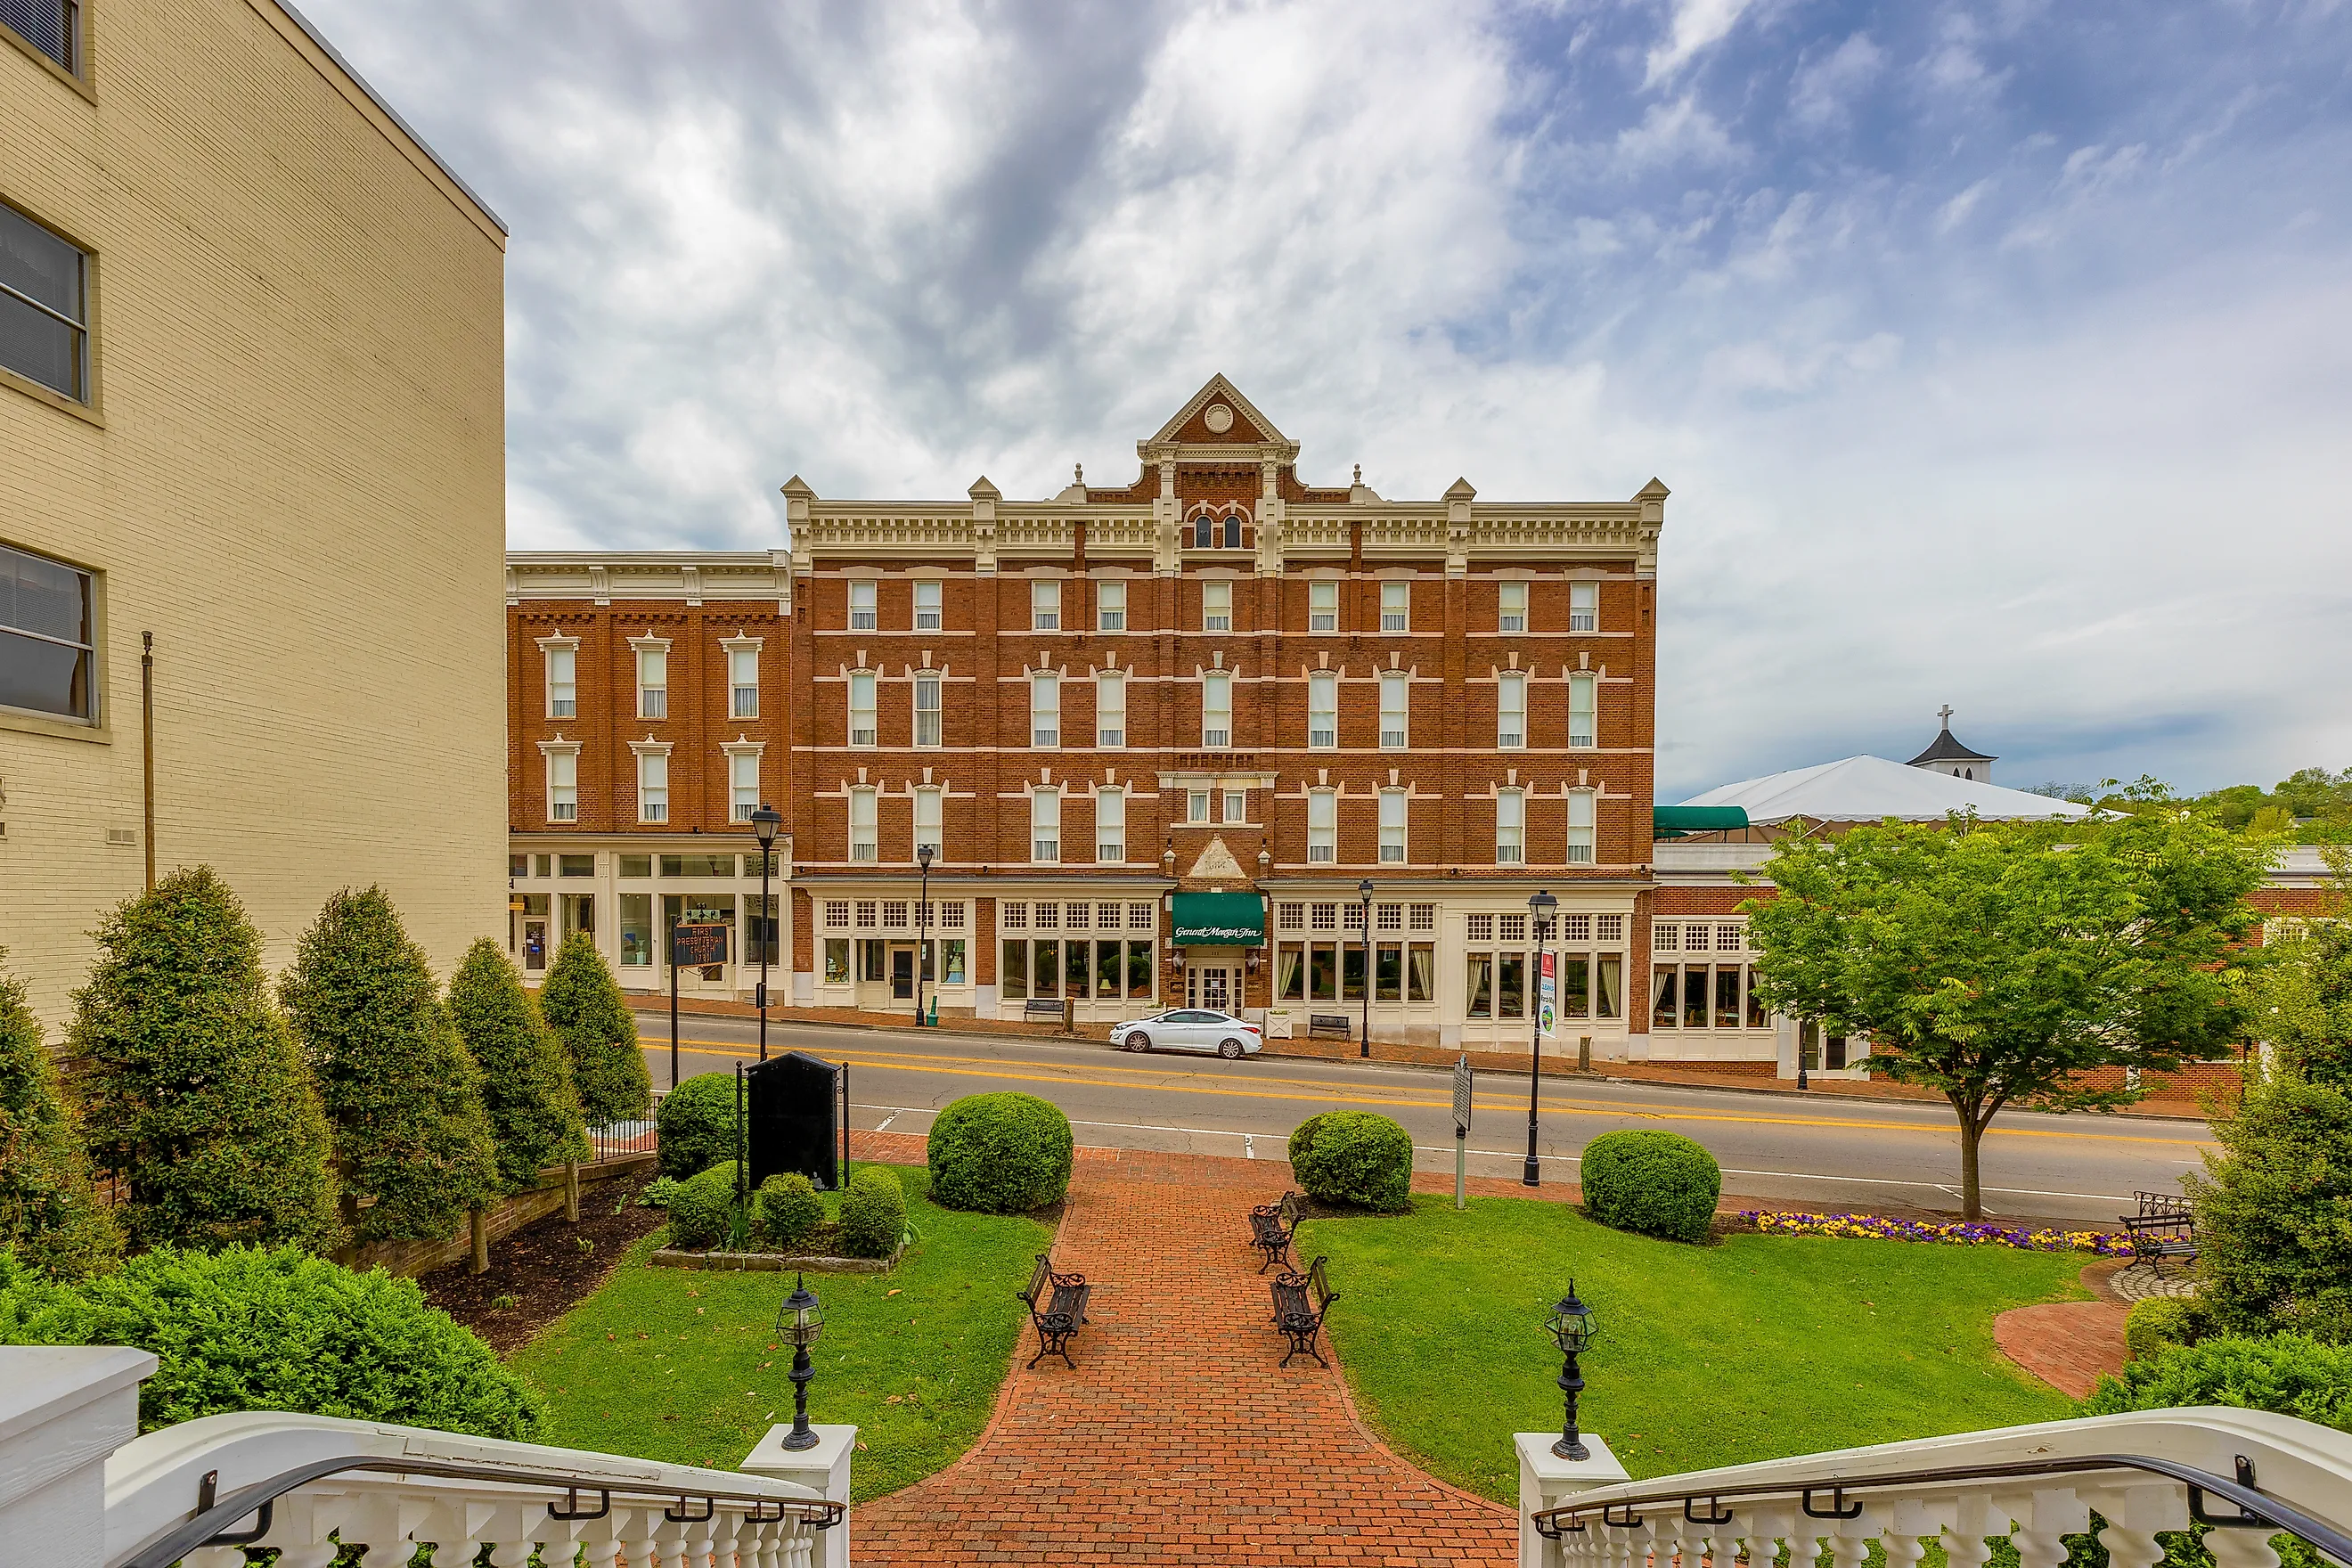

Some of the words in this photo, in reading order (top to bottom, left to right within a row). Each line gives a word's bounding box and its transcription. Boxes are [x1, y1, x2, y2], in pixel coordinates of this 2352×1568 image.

[692, 927, 712, 935] FIRST
[1175, 927, 1212, 938] General
[1209, 927, 1238, 938] Morgan
[1236, 927, 1262, 938] Inn
[677, 936, 723, 944] PRESBYTERIAN
[690, 945, 715, 953] CHURCH
